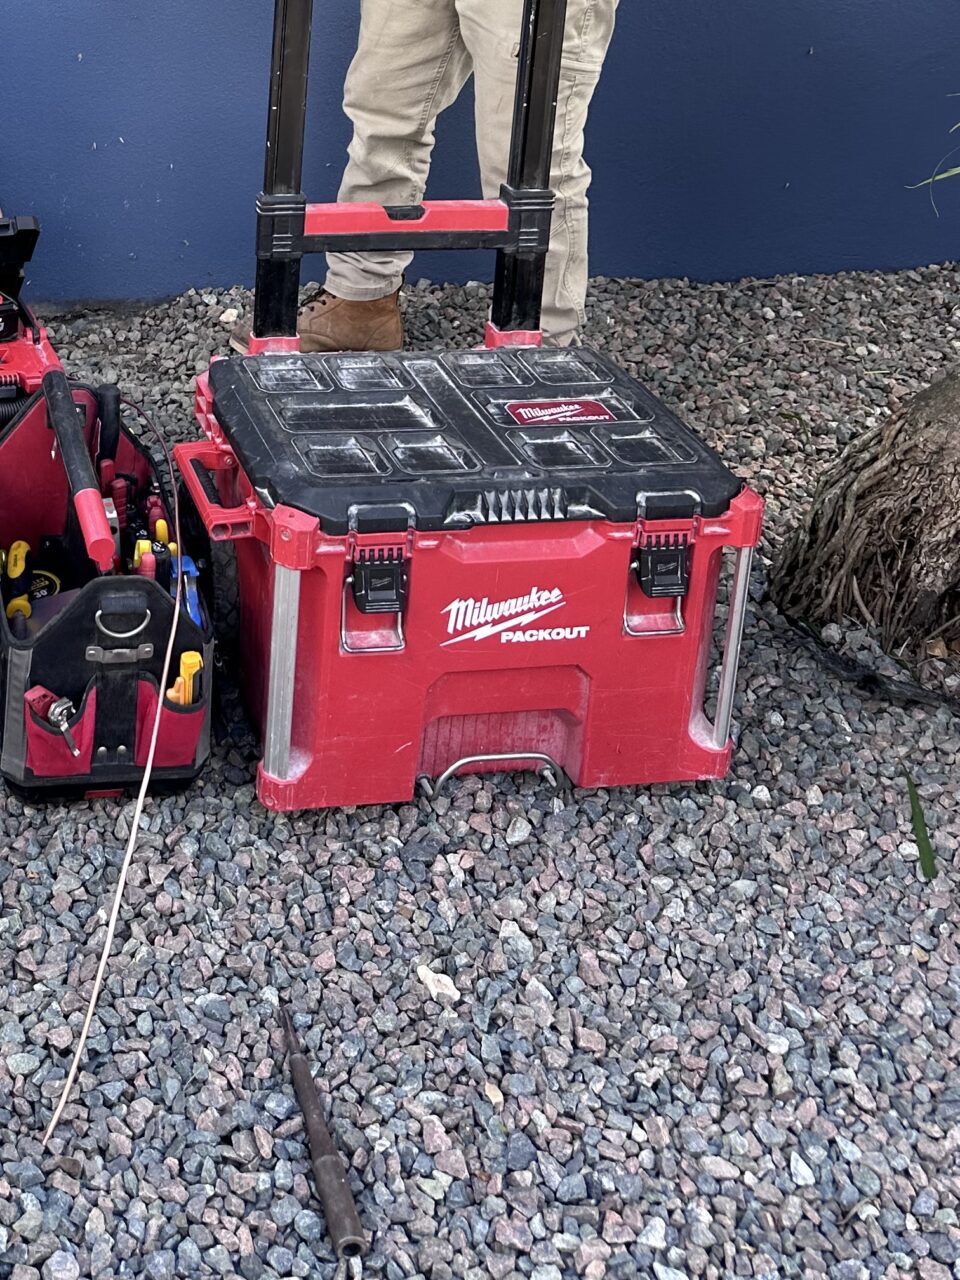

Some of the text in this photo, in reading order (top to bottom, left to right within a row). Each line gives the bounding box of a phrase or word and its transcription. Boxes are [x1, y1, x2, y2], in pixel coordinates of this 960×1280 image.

[515, 404, 582, 419] Milwaukee
[440, 586, 563, 634] Milwaukee
[500, 626, 590, 643] PACKOUT
